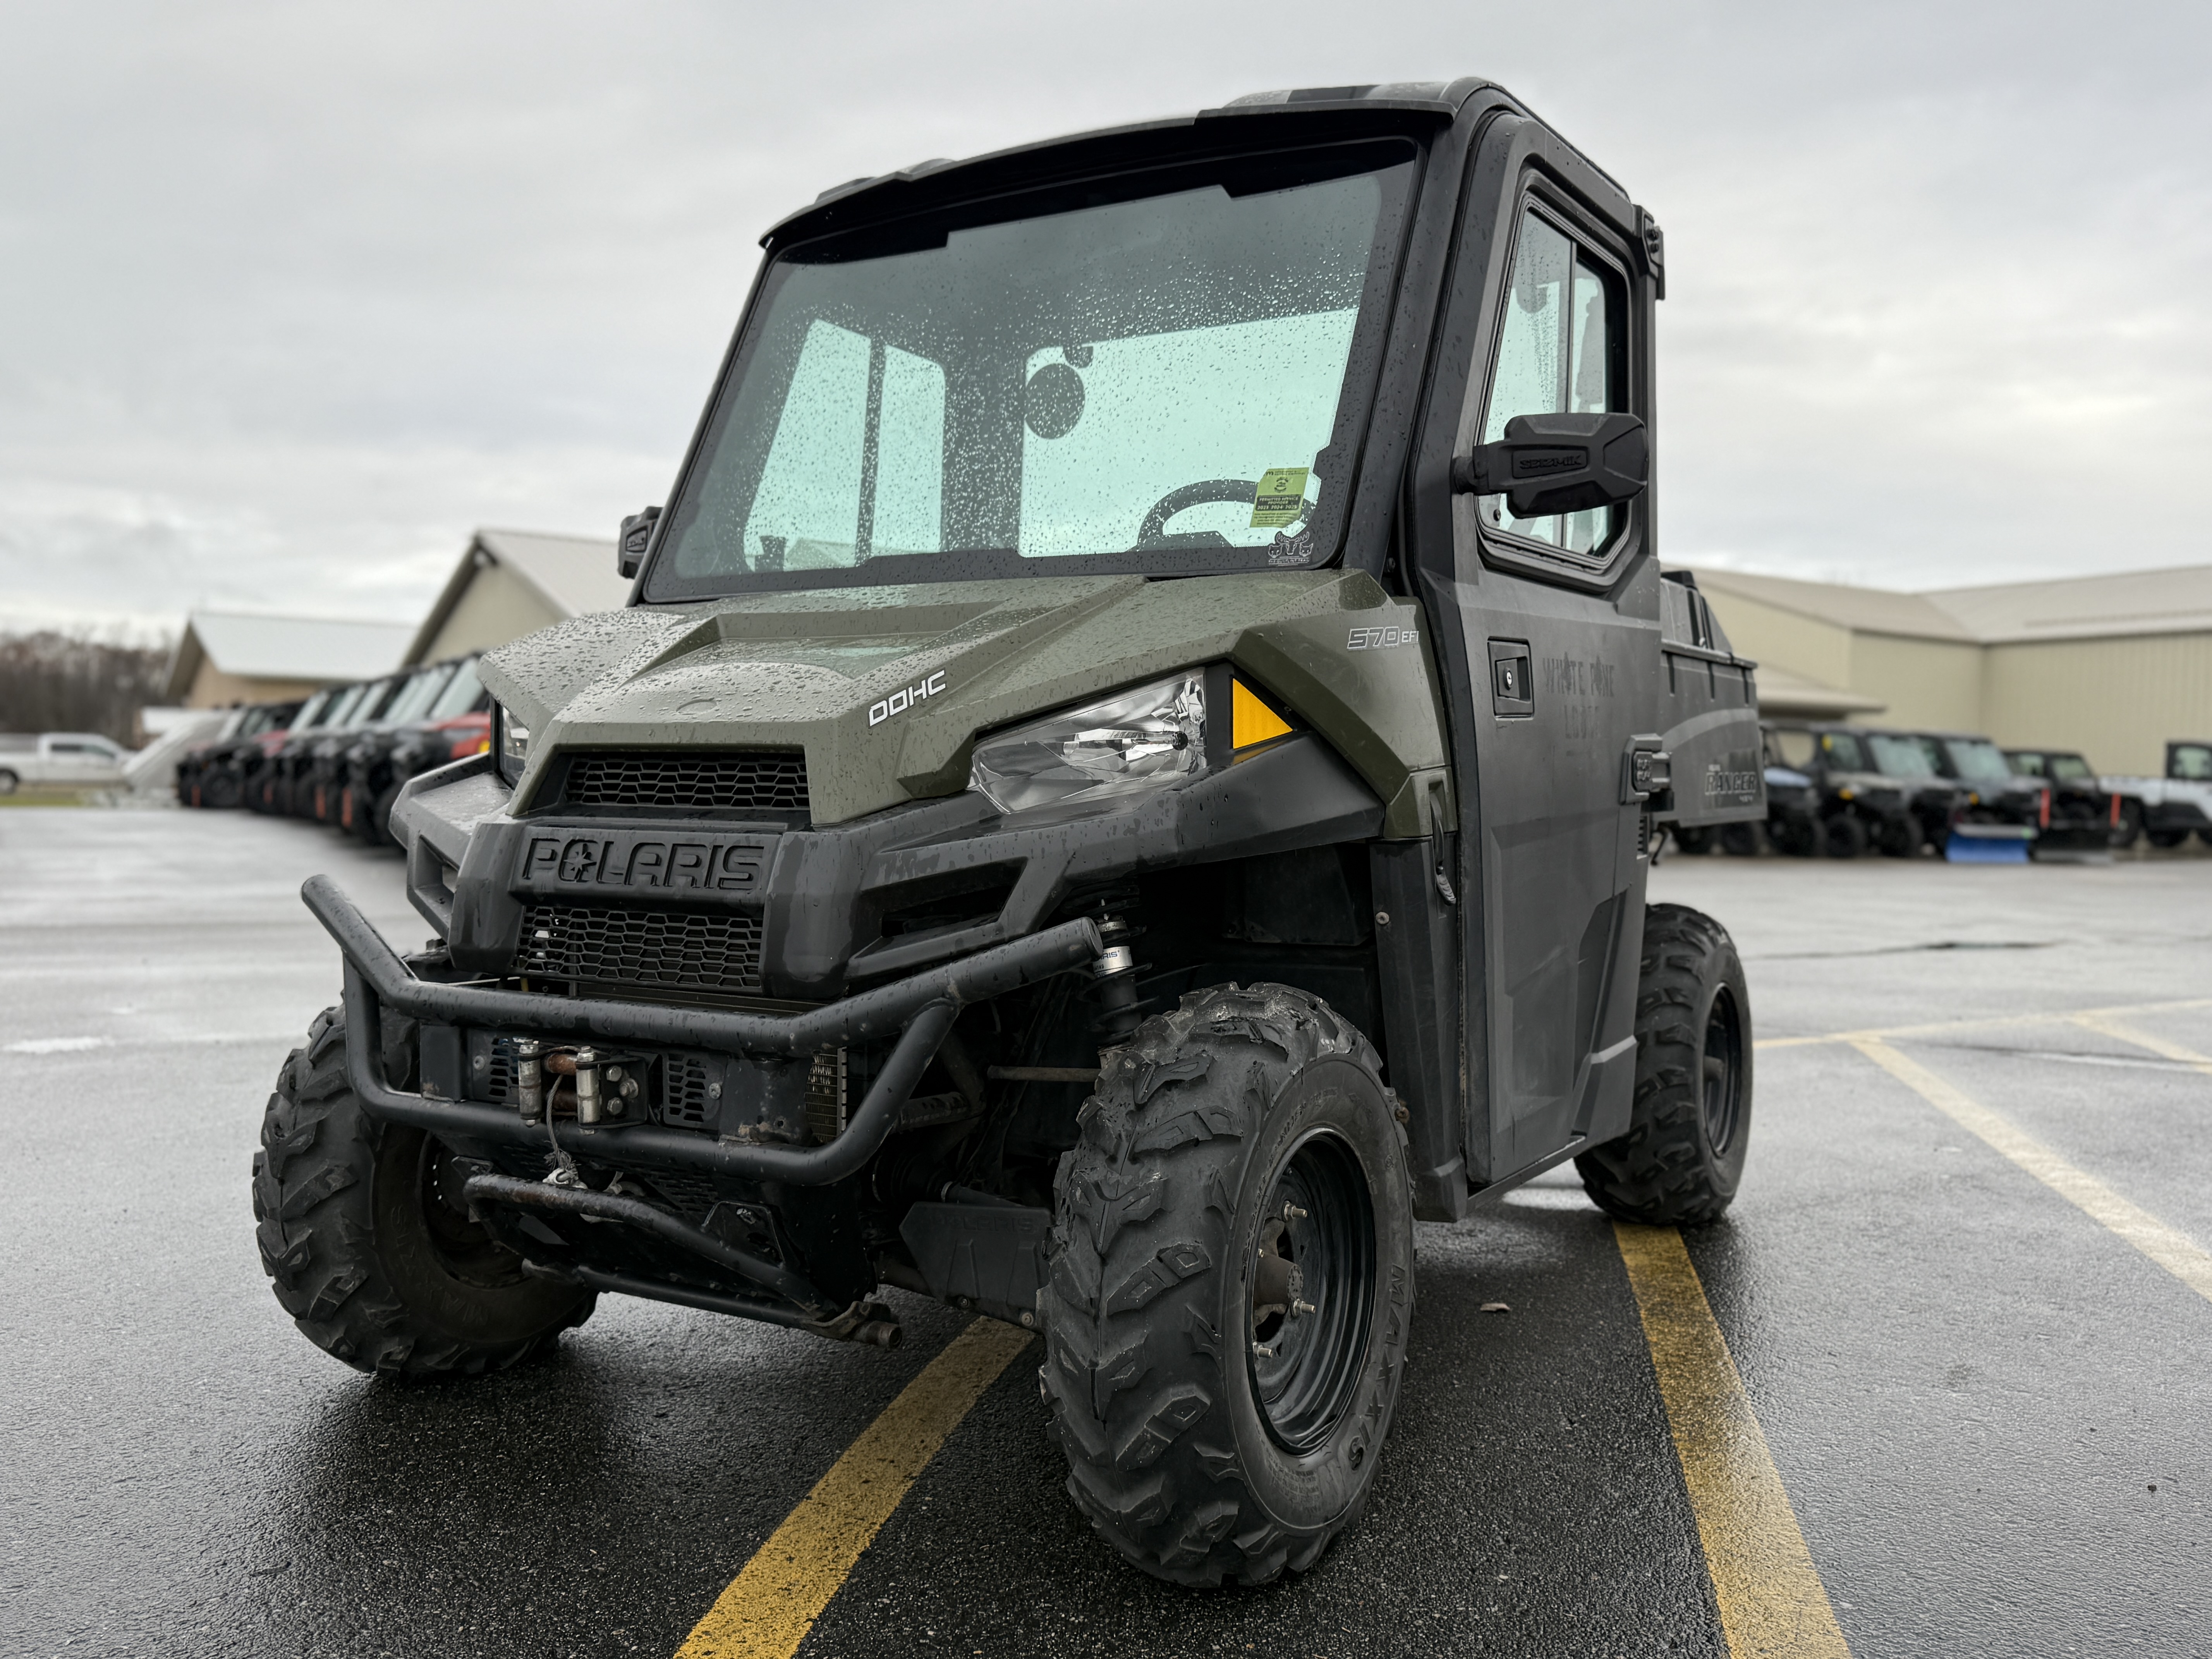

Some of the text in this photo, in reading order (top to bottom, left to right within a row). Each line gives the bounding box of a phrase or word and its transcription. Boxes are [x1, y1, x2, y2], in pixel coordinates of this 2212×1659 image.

[1519, 454, 1582, 470] SEIZMIK
[1346, 626, 1419, 649] 570 EFI
[869, 670, 946, 726] DOHC
[1704, 771, 1757, 795] RANGER
[522, 838, 765, 890] POLARIS
[1348, 1263, 1410, 1471] MAXXIS
